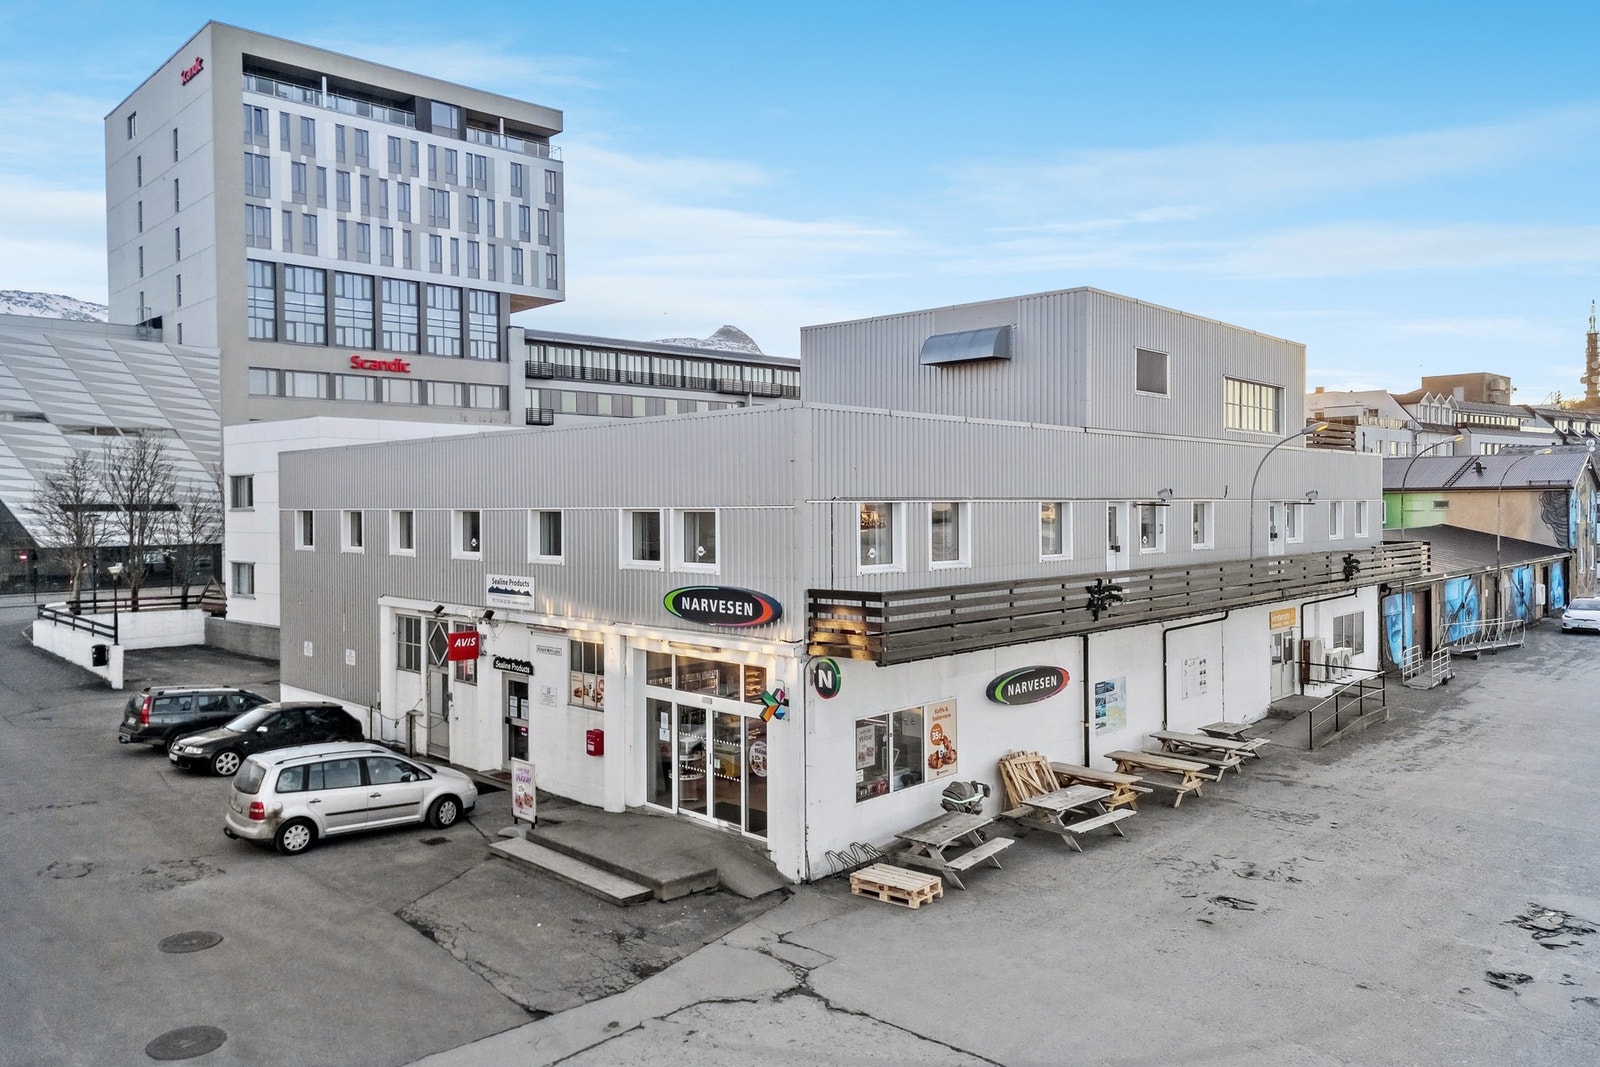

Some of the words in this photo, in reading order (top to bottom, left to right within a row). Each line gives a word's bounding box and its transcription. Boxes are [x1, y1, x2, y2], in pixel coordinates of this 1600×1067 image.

[181, 56, 204, 86] Scandic
[350, 355, 411, 373] Scandic
[491, 577, 508, 586] Sealine
[509, 578, 530, 588] Products
[681, 596, 753, 616] NARVESEN
[454, 637, 476, 648] AVIS
[495, 660, 511, 671] Sealine
[511, 662, 531, 674] Products
[818, 669, 832, 689] N
[1007, 675, 1057, 696] NARVESEN
